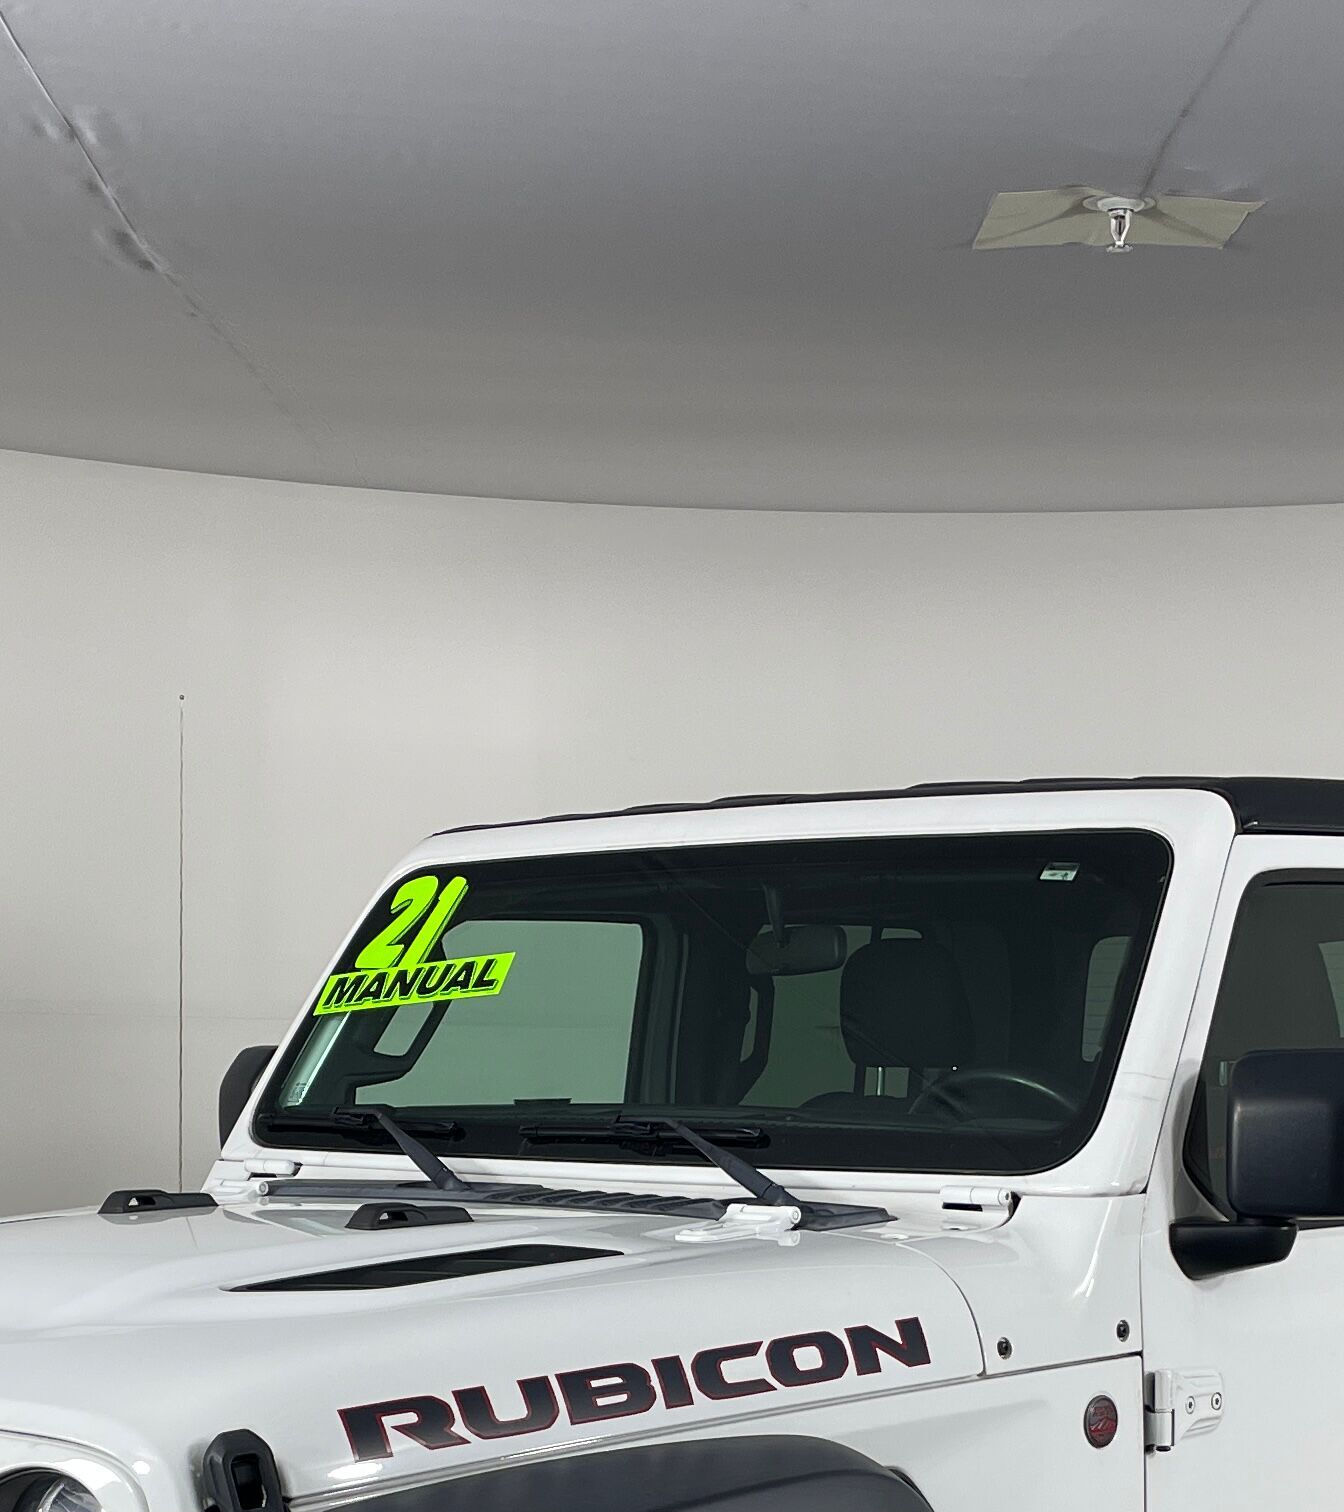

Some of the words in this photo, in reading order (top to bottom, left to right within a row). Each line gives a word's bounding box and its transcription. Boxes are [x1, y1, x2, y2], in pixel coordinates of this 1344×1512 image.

[354, 875, 469, 969] 21
[321, 956, 498, 1010] MANUAL
[337, 1316, 932, 1463] RUBICON
